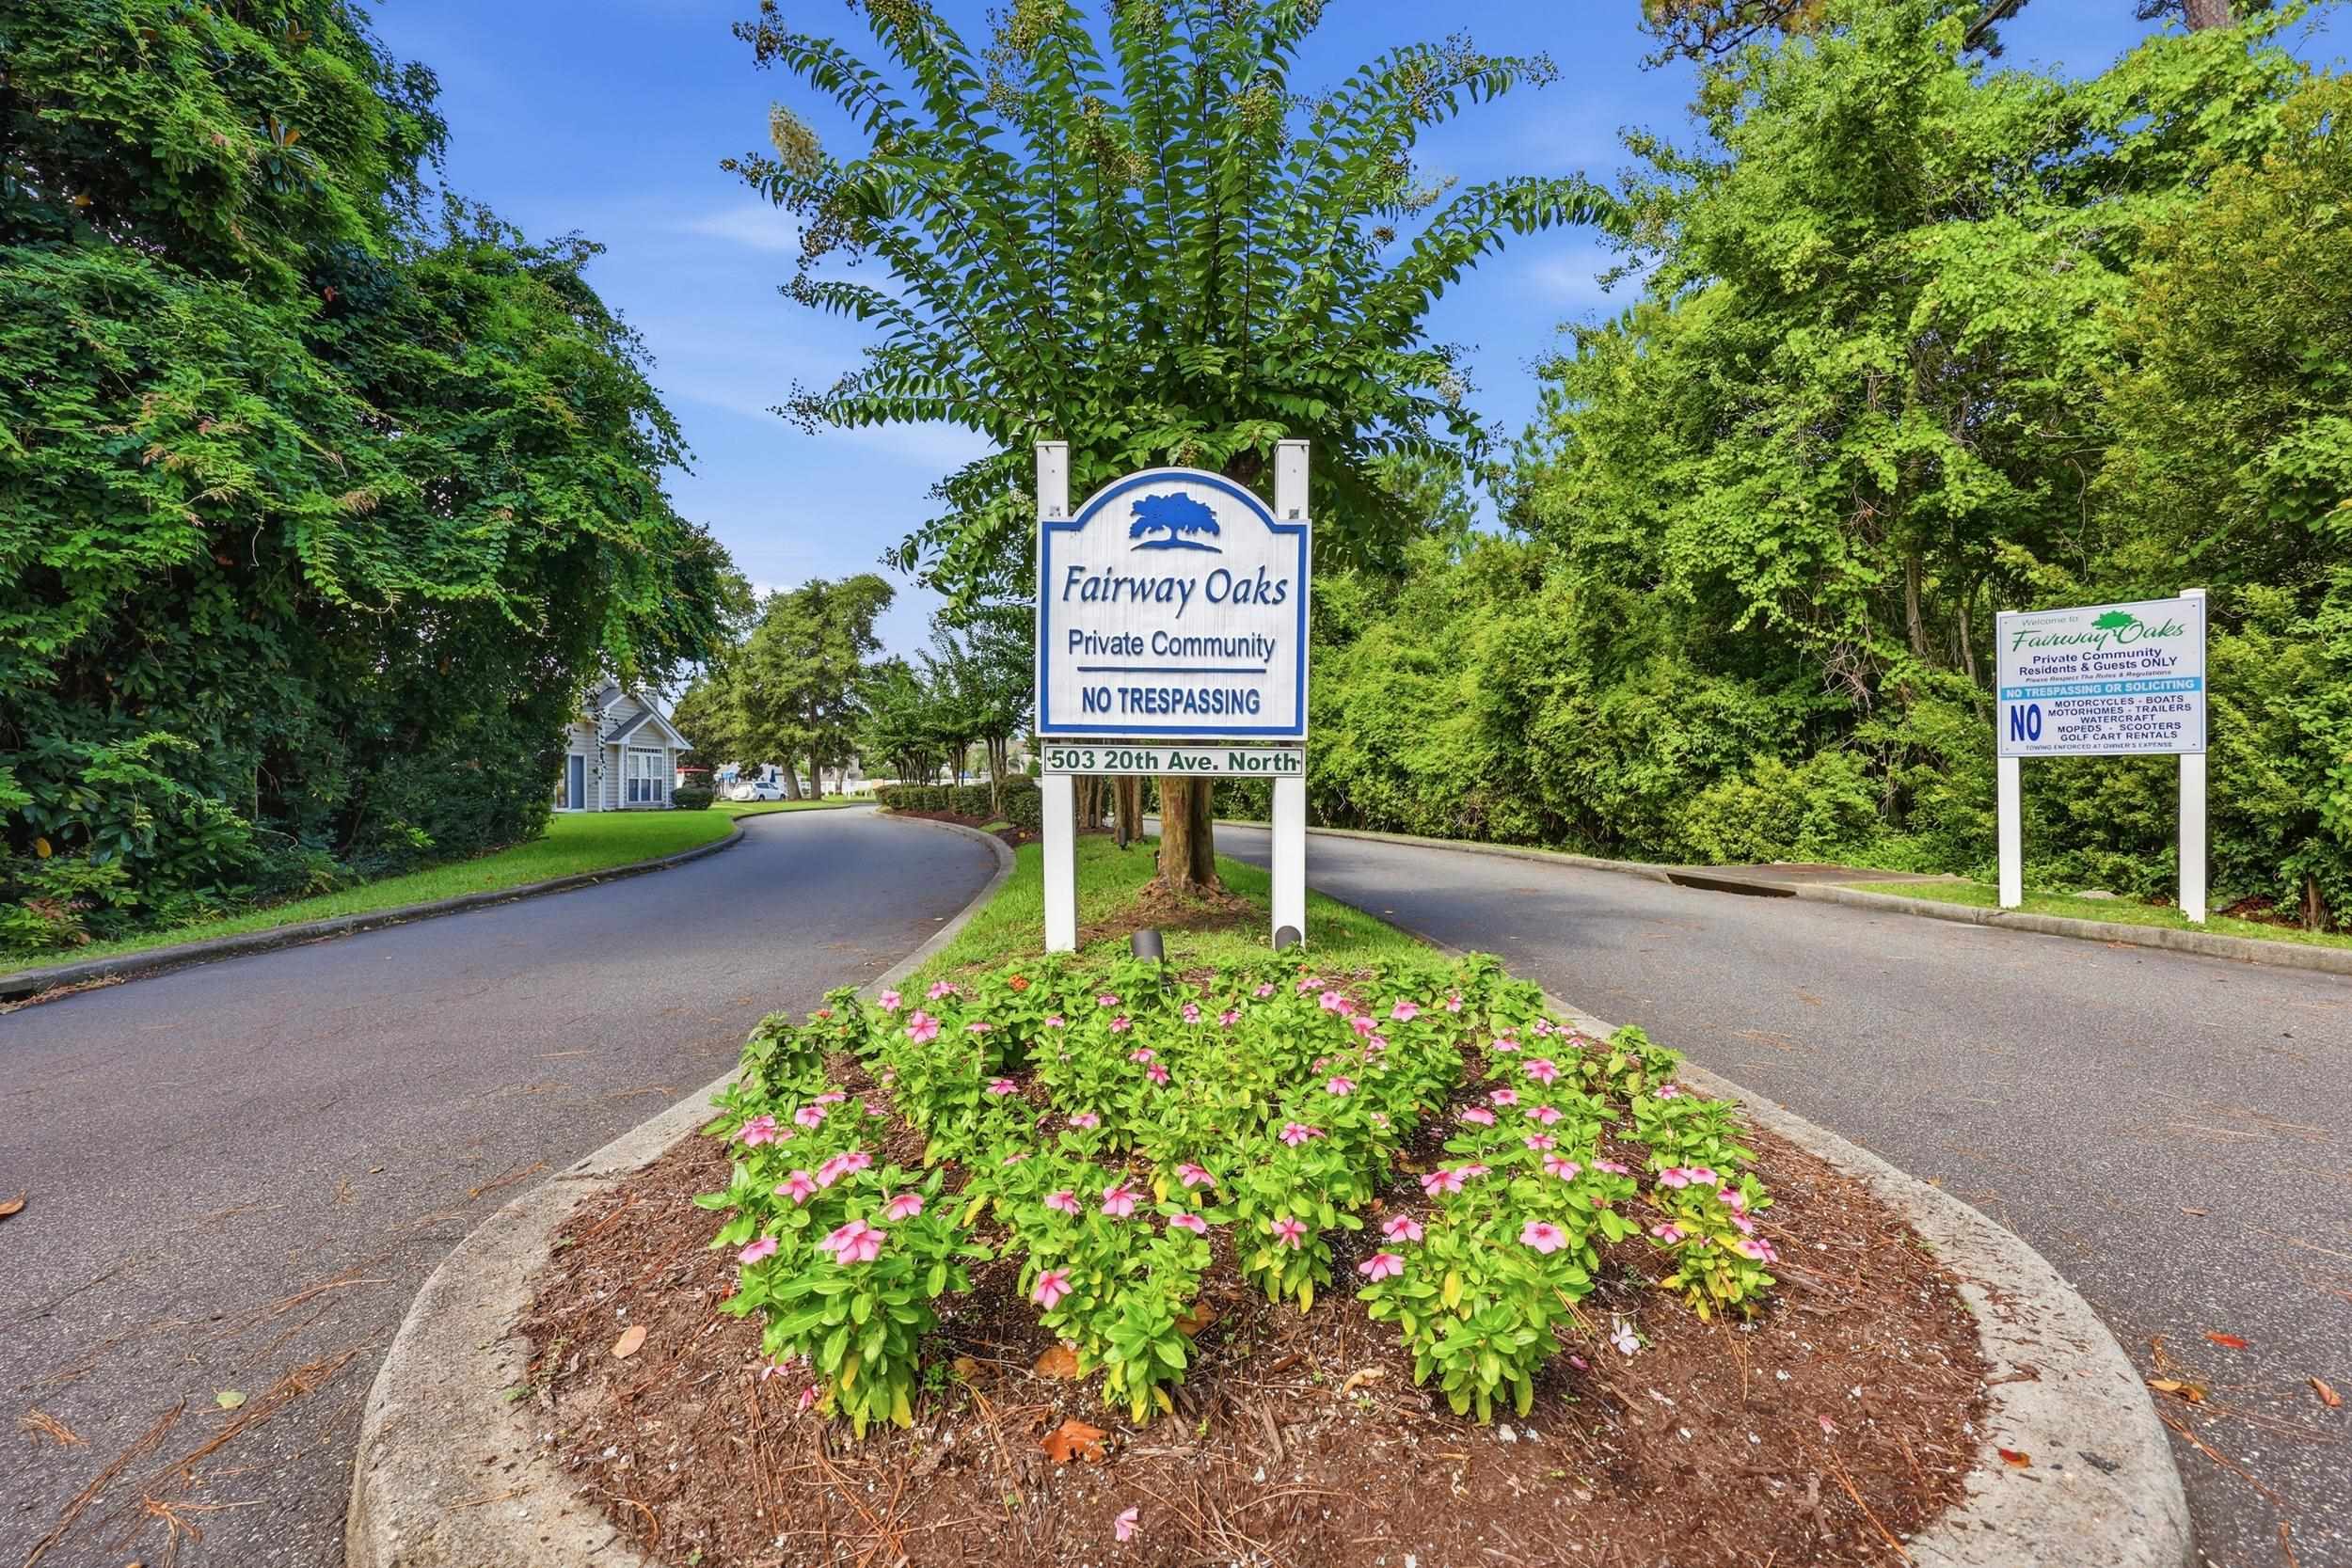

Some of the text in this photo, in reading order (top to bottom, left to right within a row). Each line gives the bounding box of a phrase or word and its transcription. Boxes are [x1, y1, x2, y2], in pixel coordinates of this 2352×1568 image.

[1062, 565, 1288, 619] Fairway Oaks
[2022, 617, 2066, 626] Welcome
[2011, 618, 2185, 652] Fairway Oaks
[1069, 629, 1275, 662] Private Community
[2032, 647, 2162, 664] Private Community
[2019, 657, 2177, 675] Residents & Guests ONLY
[2126, 669, 2172, 677] Regulations
[2006, 679, 2195, 699] NO TRESPASSING OR SOLICITING
[1082, 687, 1260, 715] NO TRESPASSING
[2055, 698, 2134, 707] MOTORCYCLES
[2146, 695, 2184, 705] BOATS
[2047, 707, 2123, 717] MOTORHOMES
[2135, 704, 2192, 713] TRAILERS
[2080, 714, 2156, 723] WATERCRAFT
[2010, 704, 2041, 741] NO
[2058, 724, 2102, 733] MOPEDS
[2120, 722, 2182, 731] SCOOTERS
[2060, 731, 2178, 741] GOLF CART RENTALS
[1051, 751, 1297, 770] 503 20th Ave. North
